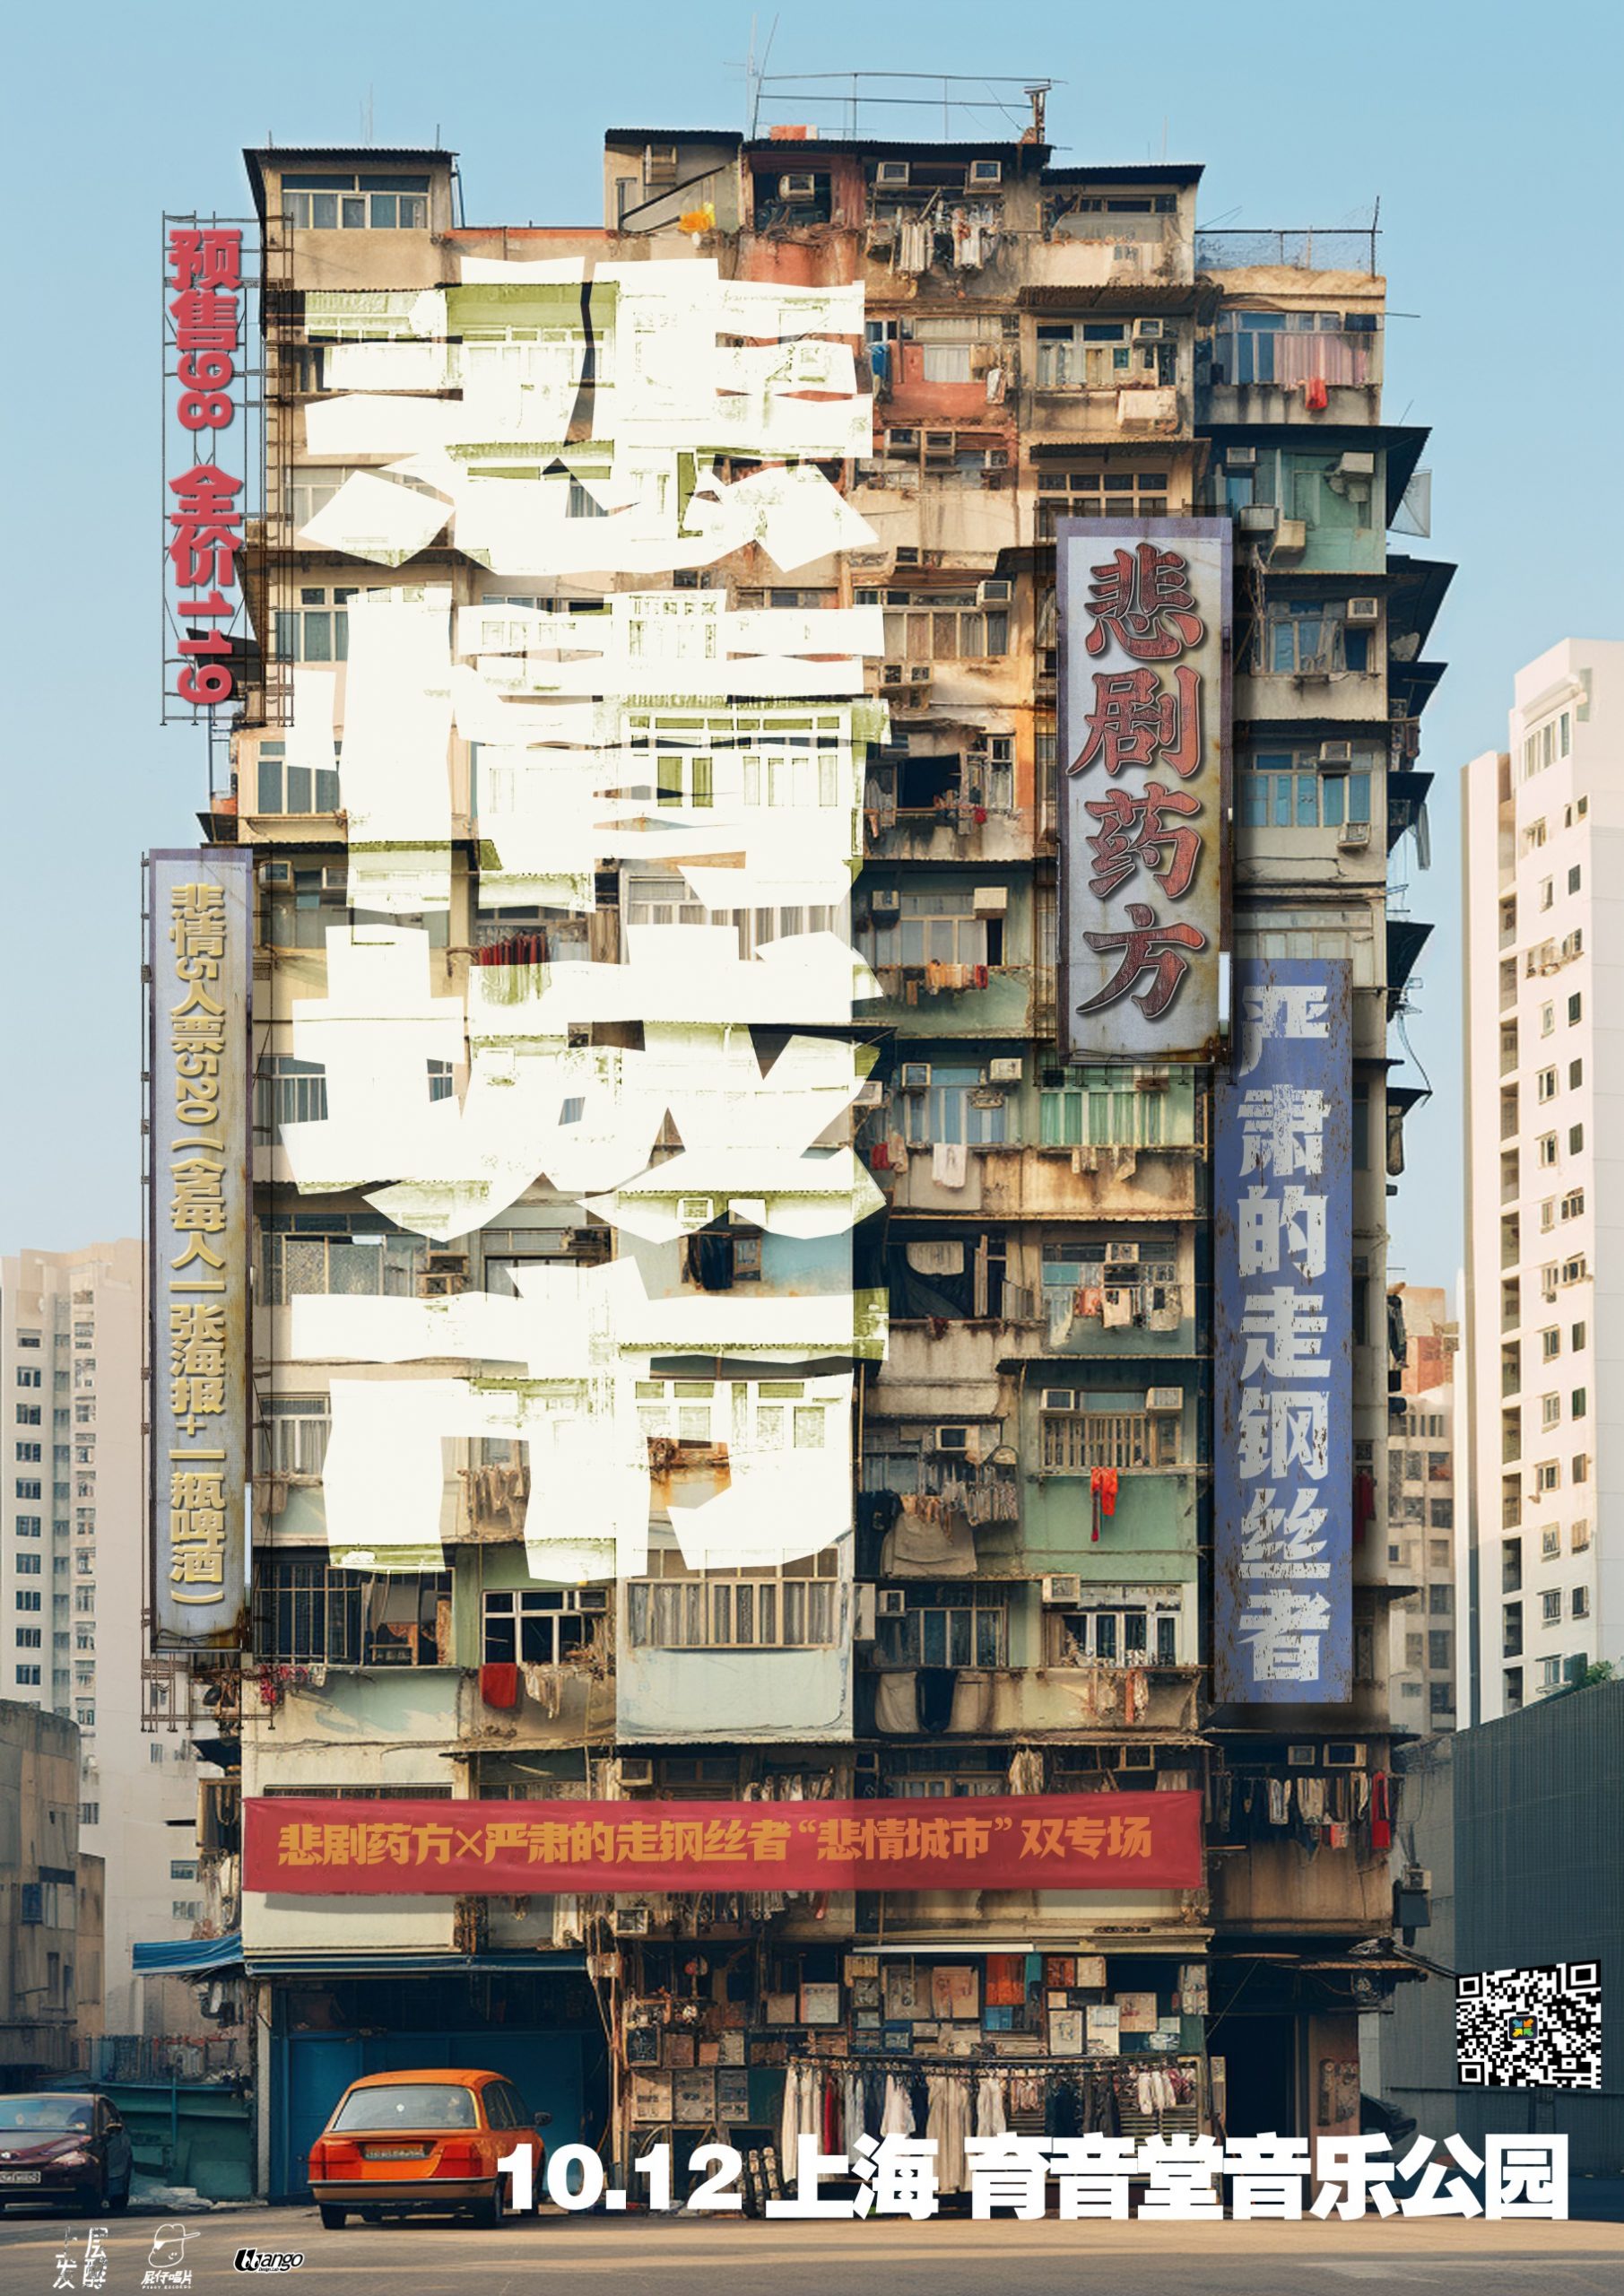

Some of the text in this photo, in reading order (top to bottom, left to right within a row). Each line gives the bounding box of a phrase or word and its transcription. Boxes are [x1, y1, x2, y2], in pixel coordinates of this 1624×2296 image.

[168, 228, 243, 705] 预售98 全价119
[1066, 542, 1205, 1019] 悲剧药方
[1237, 985, 1332, 1683] 严肃的走钢丝者
